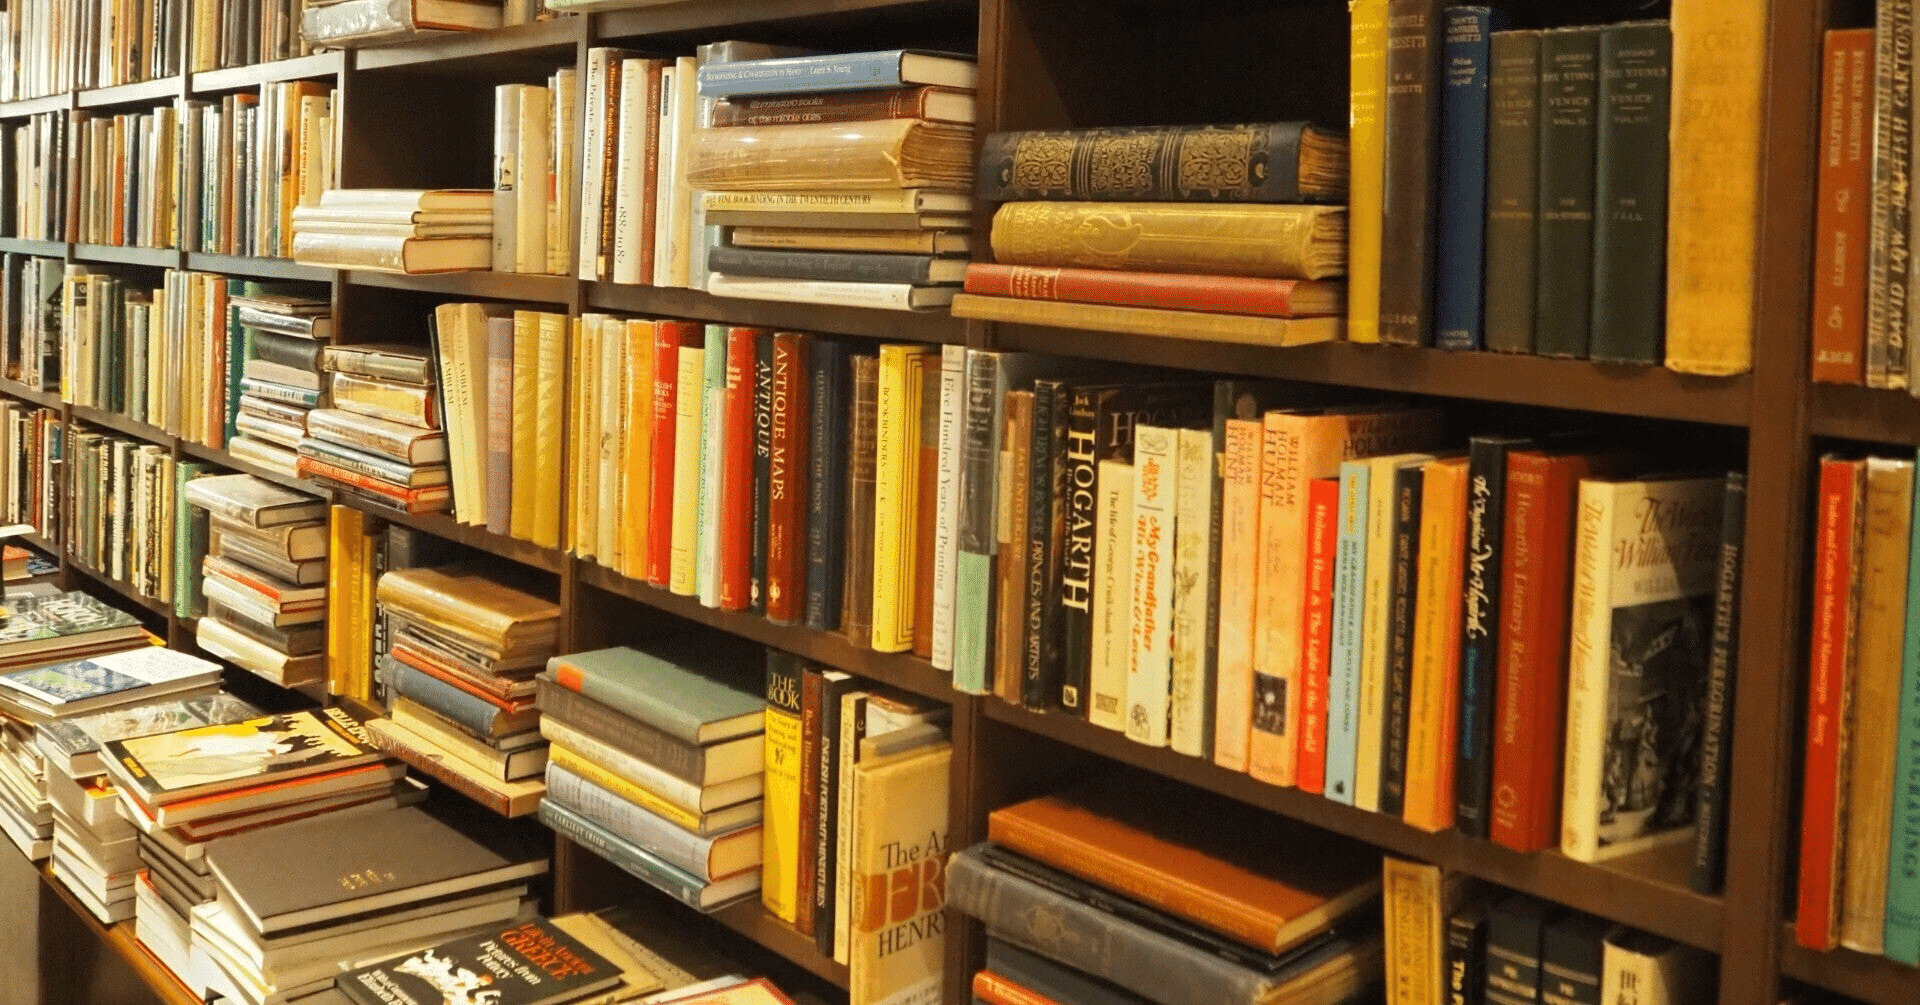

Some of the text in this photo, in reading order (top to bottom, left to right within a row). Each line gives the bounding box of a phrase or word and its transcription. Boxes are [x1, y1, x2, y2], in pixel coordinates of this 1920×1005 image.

[608, 68, 616, 94] History
[1611, 94, 1652, 103] VENICE
[1626, 68, 1667, 77] STONES
[586, 58, 598, 170] The Private Presses
[606, 108, 614, 136] English
[1550, 97, 1590, 106] VENICE
[604, 158, 612, 206] Bookbinding
[1890, 230, 1908, 274] LOW
[1888, 282, 1905, 348] DAVID
[444, 361, 454, 405] EMBLEM
[758, 360, 771, 458] ANTIQUE
[772, 348, 788, 500] ANTIQUE MAPS
[816, 369, 824, 452] ILLUMINATING
[880, 386, 891, 468] BOOKBINDERS
[1227, 424, 1239, 484] HUNT
[1237, 426, 1246, 485] HOLMAN
[1246, 432, 1254, 484] WILLIAM
[1263, 427, 1278, 505] HUNT
[1274, 429, 1288, 507] HOLMAN
[1286, 435, 1300, 506] WILLIAM
[815, 482, 823, 513] BOOK
[936, 378, 954, 592] Five Hundred Years of Printing
[1016, 482, 1024, 514] INTO
[1109, 490, 1119, 509] The
[1473, 476, 1490, 497] The
[1827, 493, 1841, 528] Trades
[1062, 429, 1095, 614] HOGARTH
[1108, 509, 1118, 527] life
[1108, 528, 1117, 538] of
[1583, 500, 1605, 523] The
[1105, 539, 1116, 575] George
[1826, 530, 1838, 549] and
[1031, 540, 1043, 596] PRINCES
[1132, 514, 1147, 674] His Wives & Loves
[1143, 516, 1161, 652] My Grandfather
[1714, 544, 1738, 642] HOGARTH'S
[1030, 598, 1041, 630] AND
[1104, 576, 1116, 635] Cruikshank
[1305, 505, 1327, 752] Holman Hunt & The Light of the World
[1463, 577, 1489, 640] Hogarth
[1504, 493, 1531, 744] Hogarth's Literary Relationships
[1028, 633, 1040, 680] ARTISTS
[1816, 642, 1832, 705] Manuscripts
[768, 686, 801, 710] BOOK
[770, 672, 795, 694] THE
[1702, 647, 1729, 787] PEREGRINATION
[802, 709, 813, 795] Book Illustrated
[817, 736, 830, 908] ENGLISH PORTRAIT MINIATURES
[880, 841, 920, 870] The
[878, 910, 947, 959] HENRY
[1452, 960, 1465, 991] The
